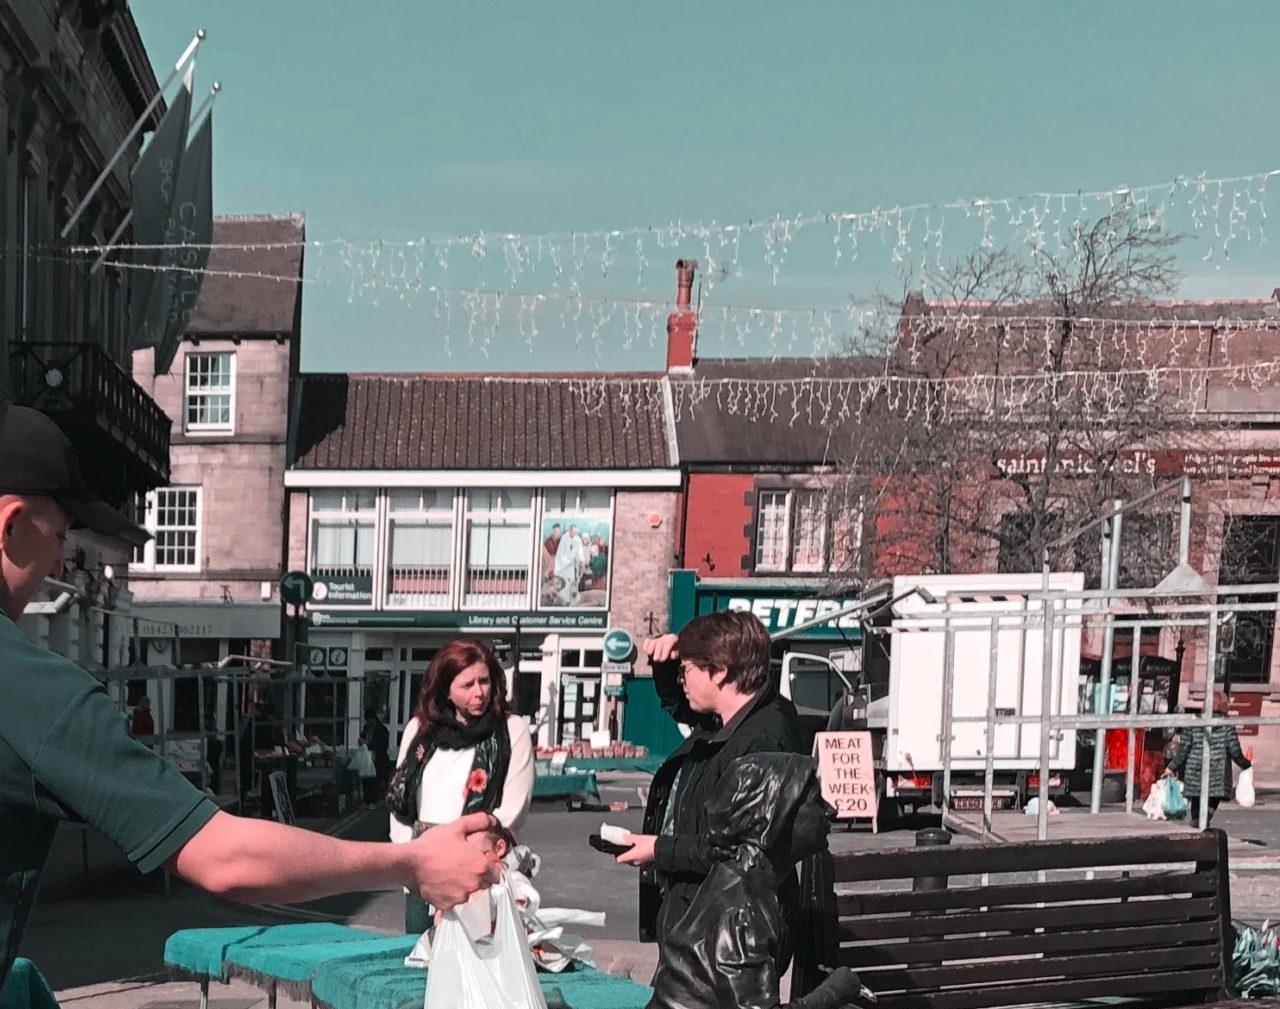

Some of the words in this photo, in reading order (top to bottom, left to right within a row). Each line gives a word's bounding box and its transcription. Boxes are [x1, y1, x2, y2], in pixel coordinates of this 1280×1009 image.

[997, 453, 1048, 475] saint
[1054, 451, 1156, 476] micel's
[328, 582, 355, 591] Tourist
[328, 590, 372, 600] Information
[468, 615, 494, 626] Library
[496, 615, 510, 625] and
[548, 615, 576, 625] Service
[578, 615, 603, 625] Centre
[825, 738, 863, 749] MEAT
[832, 753, 861, 764] FOR
[835, 768, 862, 779] THE
[828, 783, 869, 795] WEEK
[835, 798, 868, 811] £20
